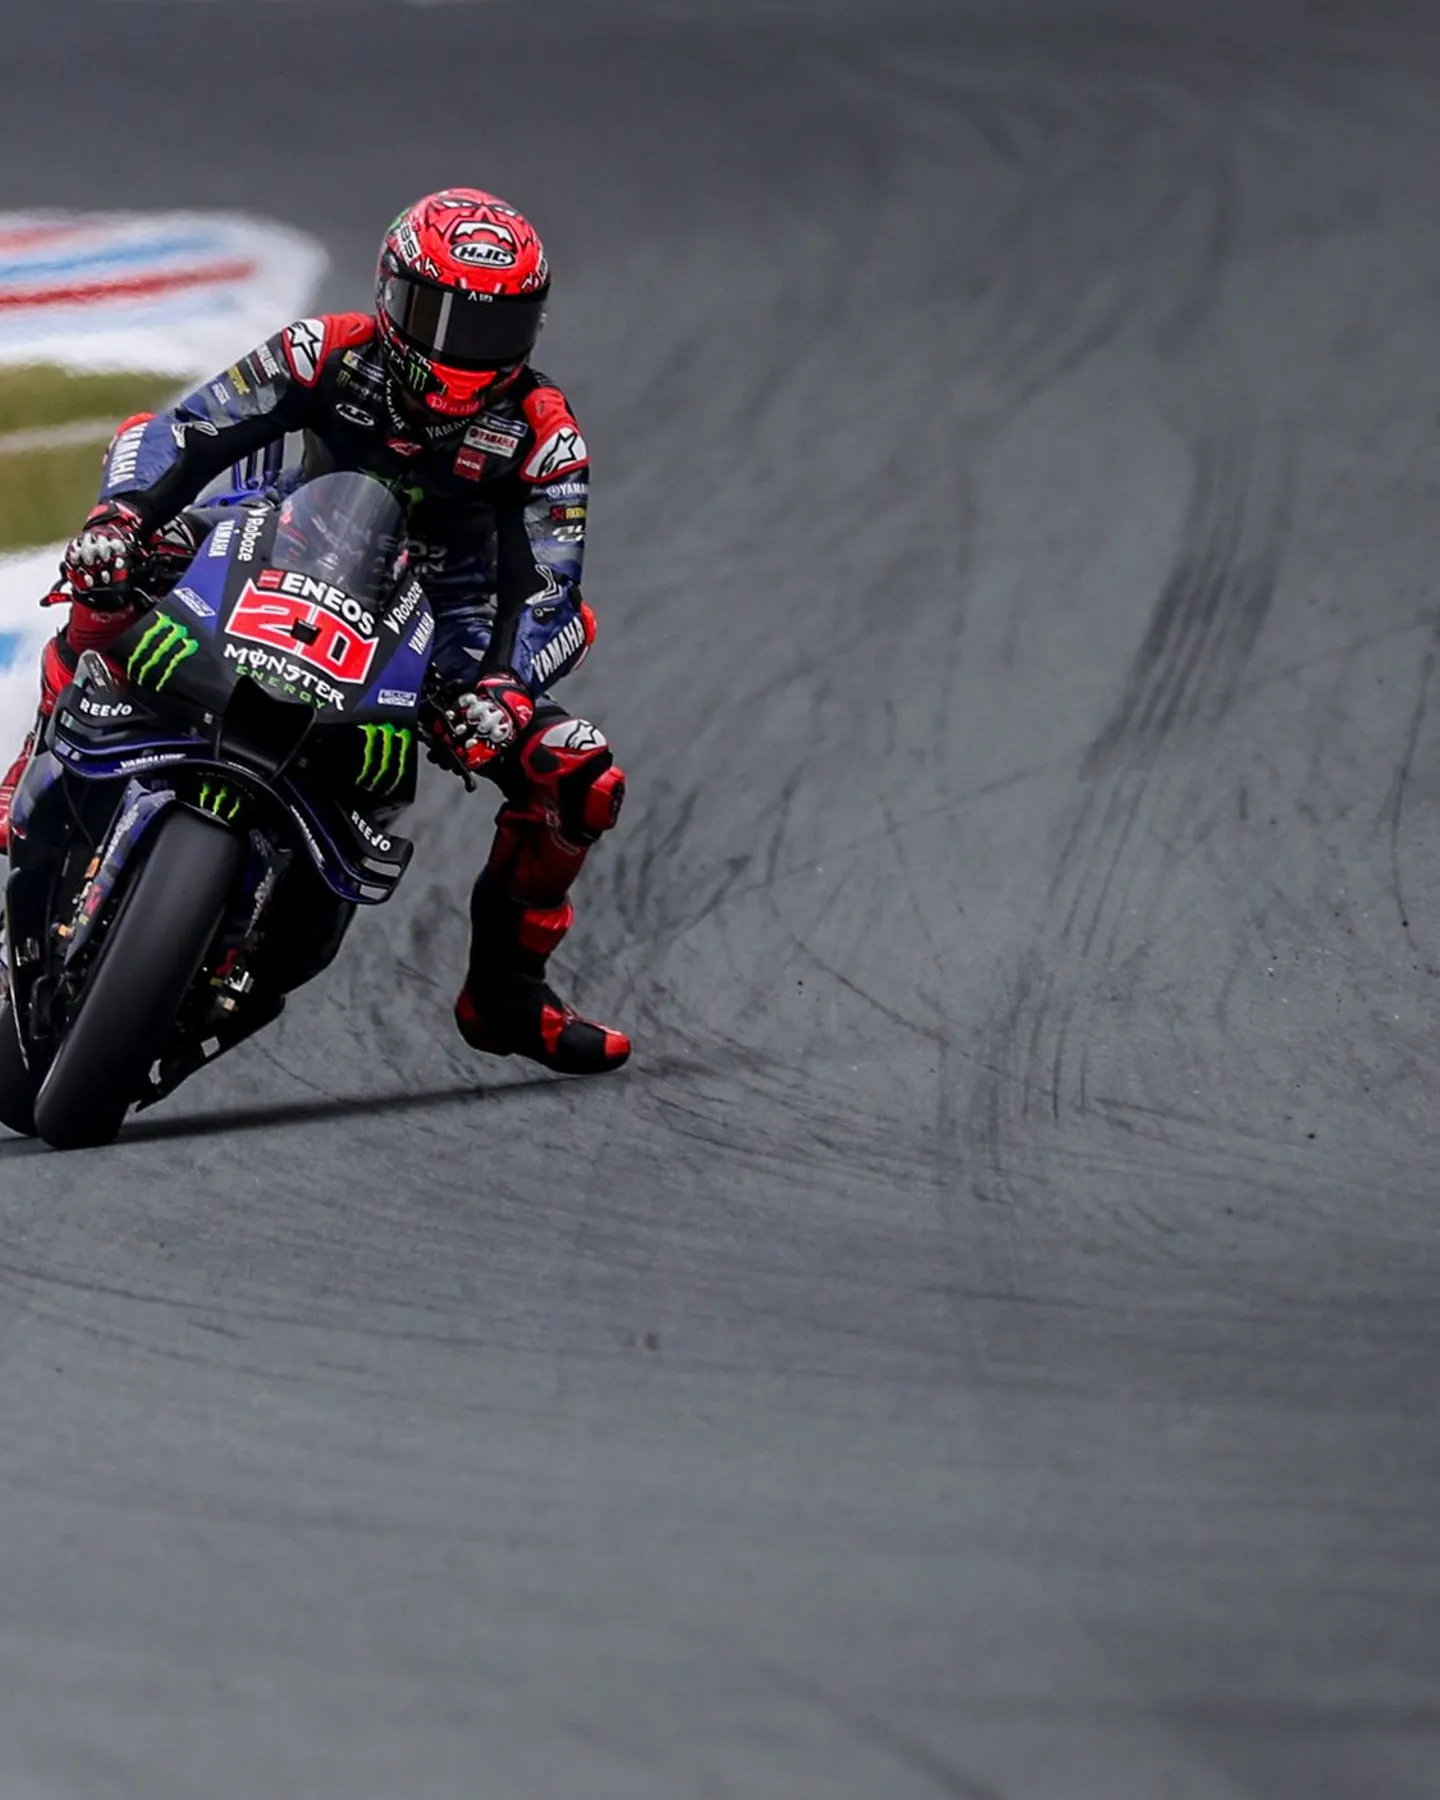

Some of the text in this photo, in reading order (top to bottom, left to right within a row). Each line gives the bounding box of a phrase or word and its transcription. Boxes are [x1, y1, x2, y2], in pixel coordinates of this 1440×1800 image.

[460, 246, 509, 264] HJC
[107, 422, 149, 488] YAMAHA
[208, 520, 235, 558] YAMAHA
[238, 518, 265, 561] Roboze
[280, 571, 375, 636] ENEOS
[392, 581, 423, 625] Roboze
[224, 577, 379, 685] 20
[408, 611, 435, 655] YAMAHA
[530, 615, 586, 683] YAMAHA
[223, 643, 345, 711] MONSTER
[235, 663, 327, 709] ENERGY
